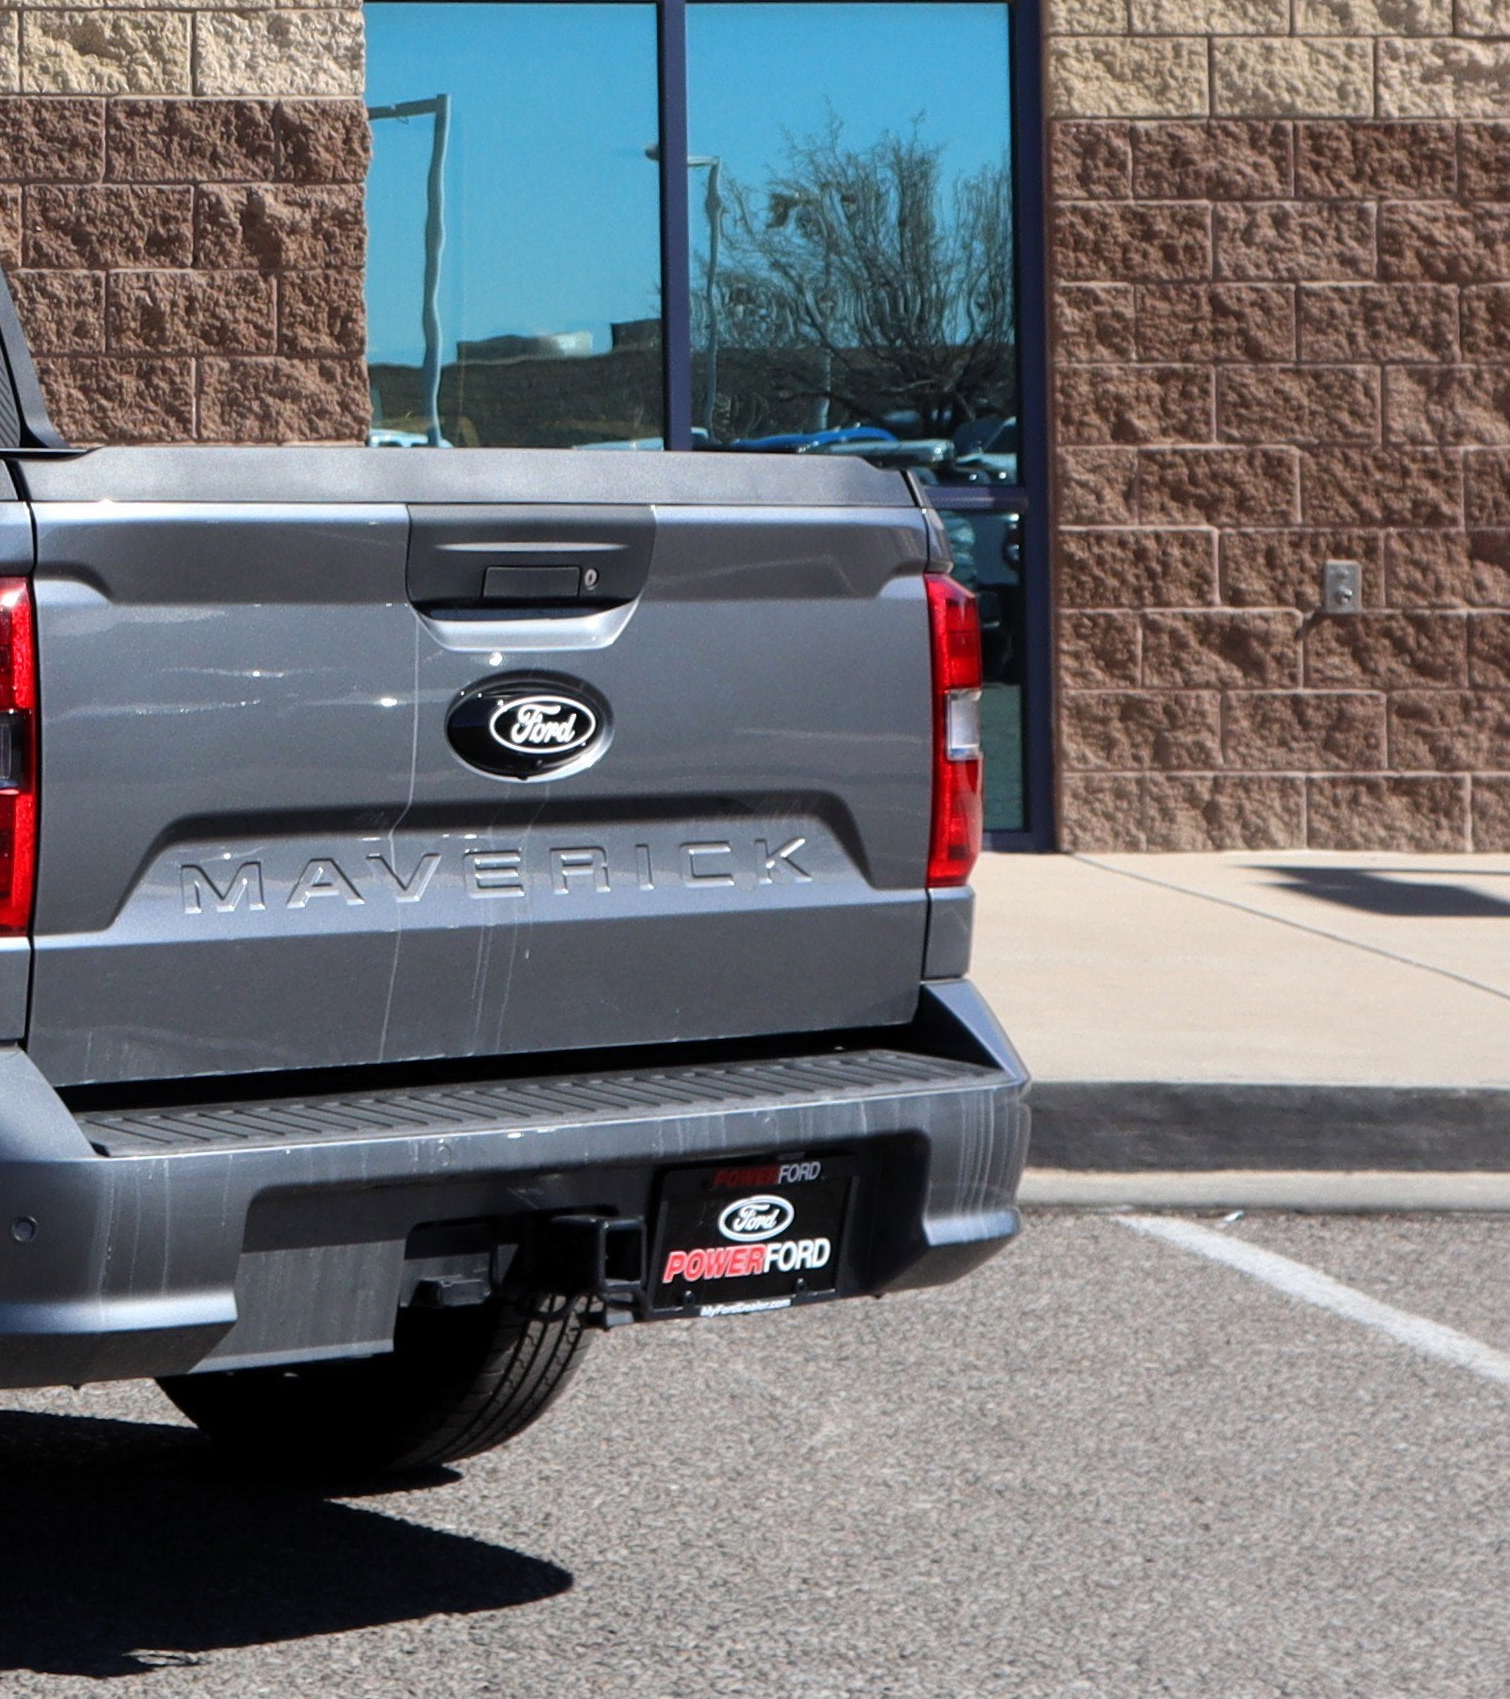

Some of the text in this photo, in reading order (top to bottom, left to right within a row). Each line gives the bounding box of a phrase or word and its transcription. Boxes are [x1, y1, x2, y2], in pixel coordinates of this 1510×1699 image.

[511, 703, 576, 746] Ford
[179, 836, 813, 915] MAVERICK
[733, 1204, 780, 1232] Ford
[662, 1237, 831, 1284] POWERFORD
